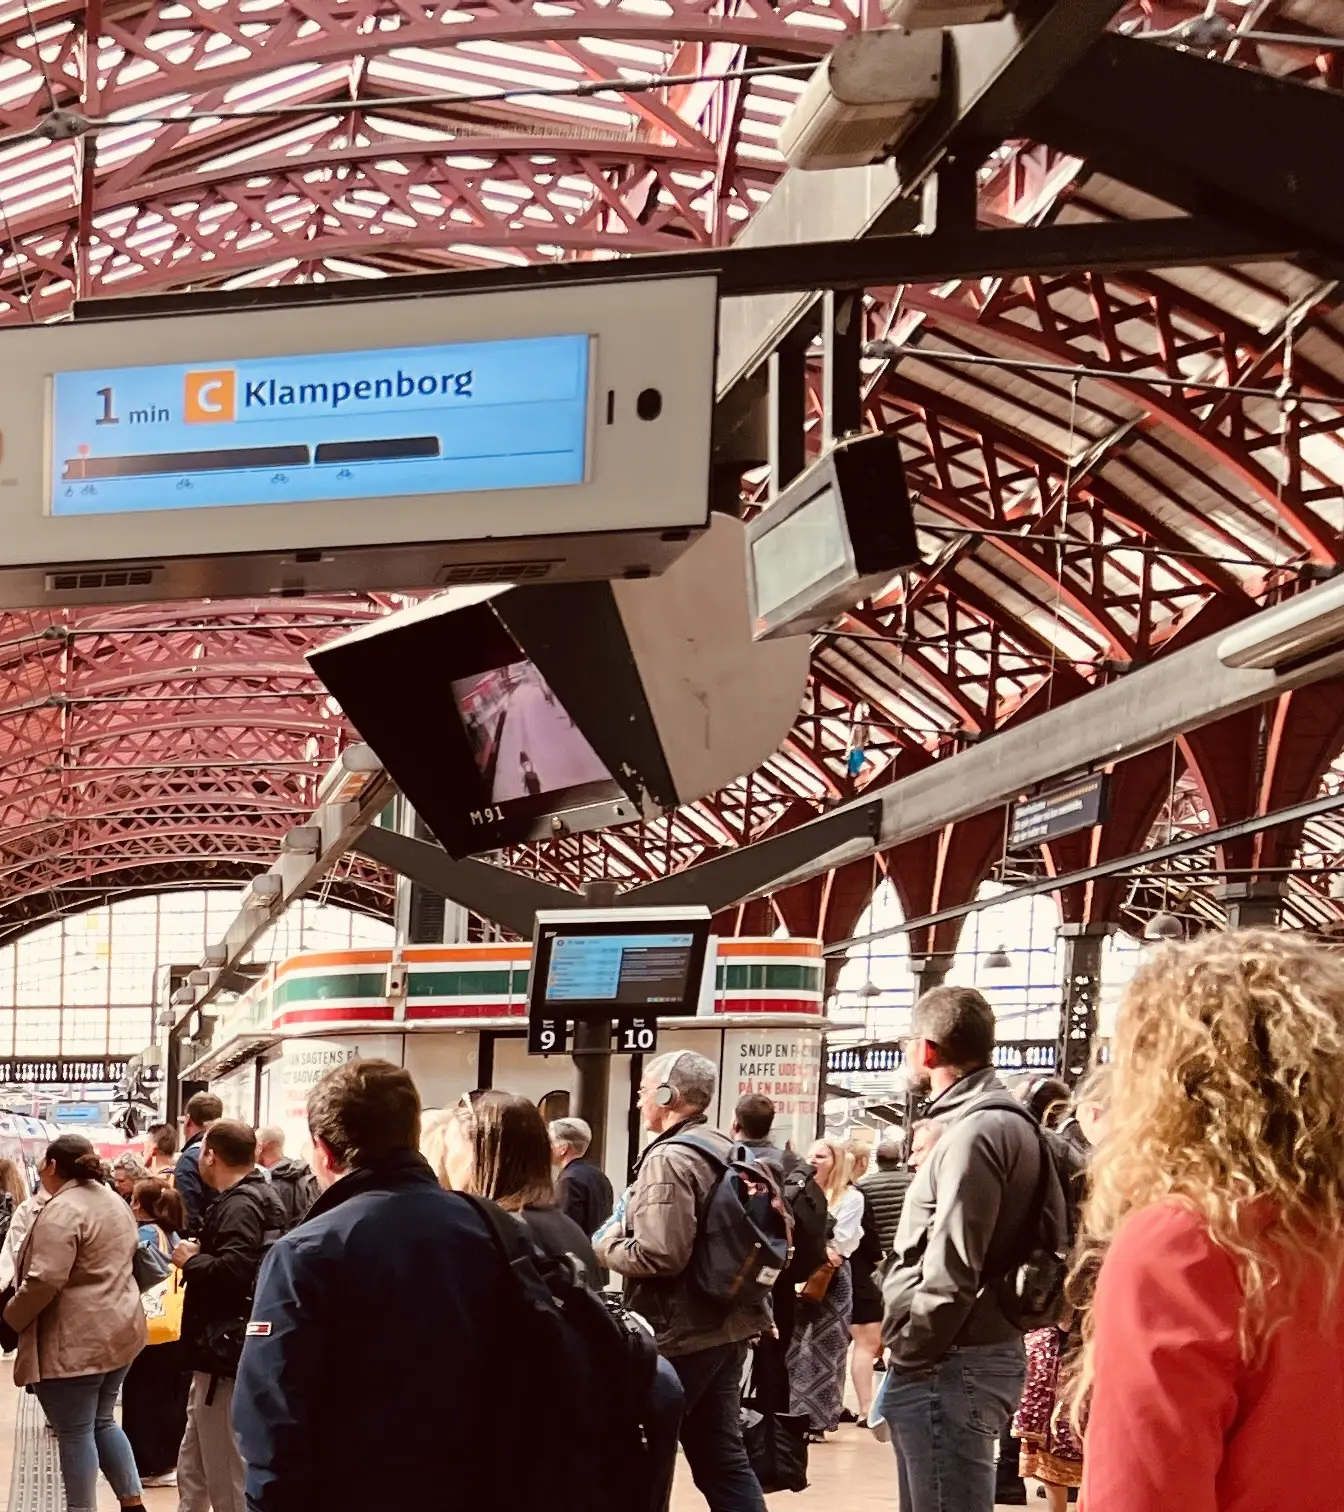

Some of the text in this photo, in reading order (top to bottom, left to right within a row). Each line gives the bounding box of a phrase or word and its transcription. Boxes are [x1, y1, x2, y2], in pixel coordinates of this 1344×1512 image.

[94, 368, 474, 426] 1 min C Klampenborg
[470, 805, 505, 825] M91
[540, 1030, 556, 1049] 9
[624, 1029, 653, 1048] 10
[740, 1044, 772, 1057] SNUP
[775, 1044, 788, 1057] EN
[739, 1063, 775, 1076] KAFFE
[738, 1078, 753, 1094] PÅ
